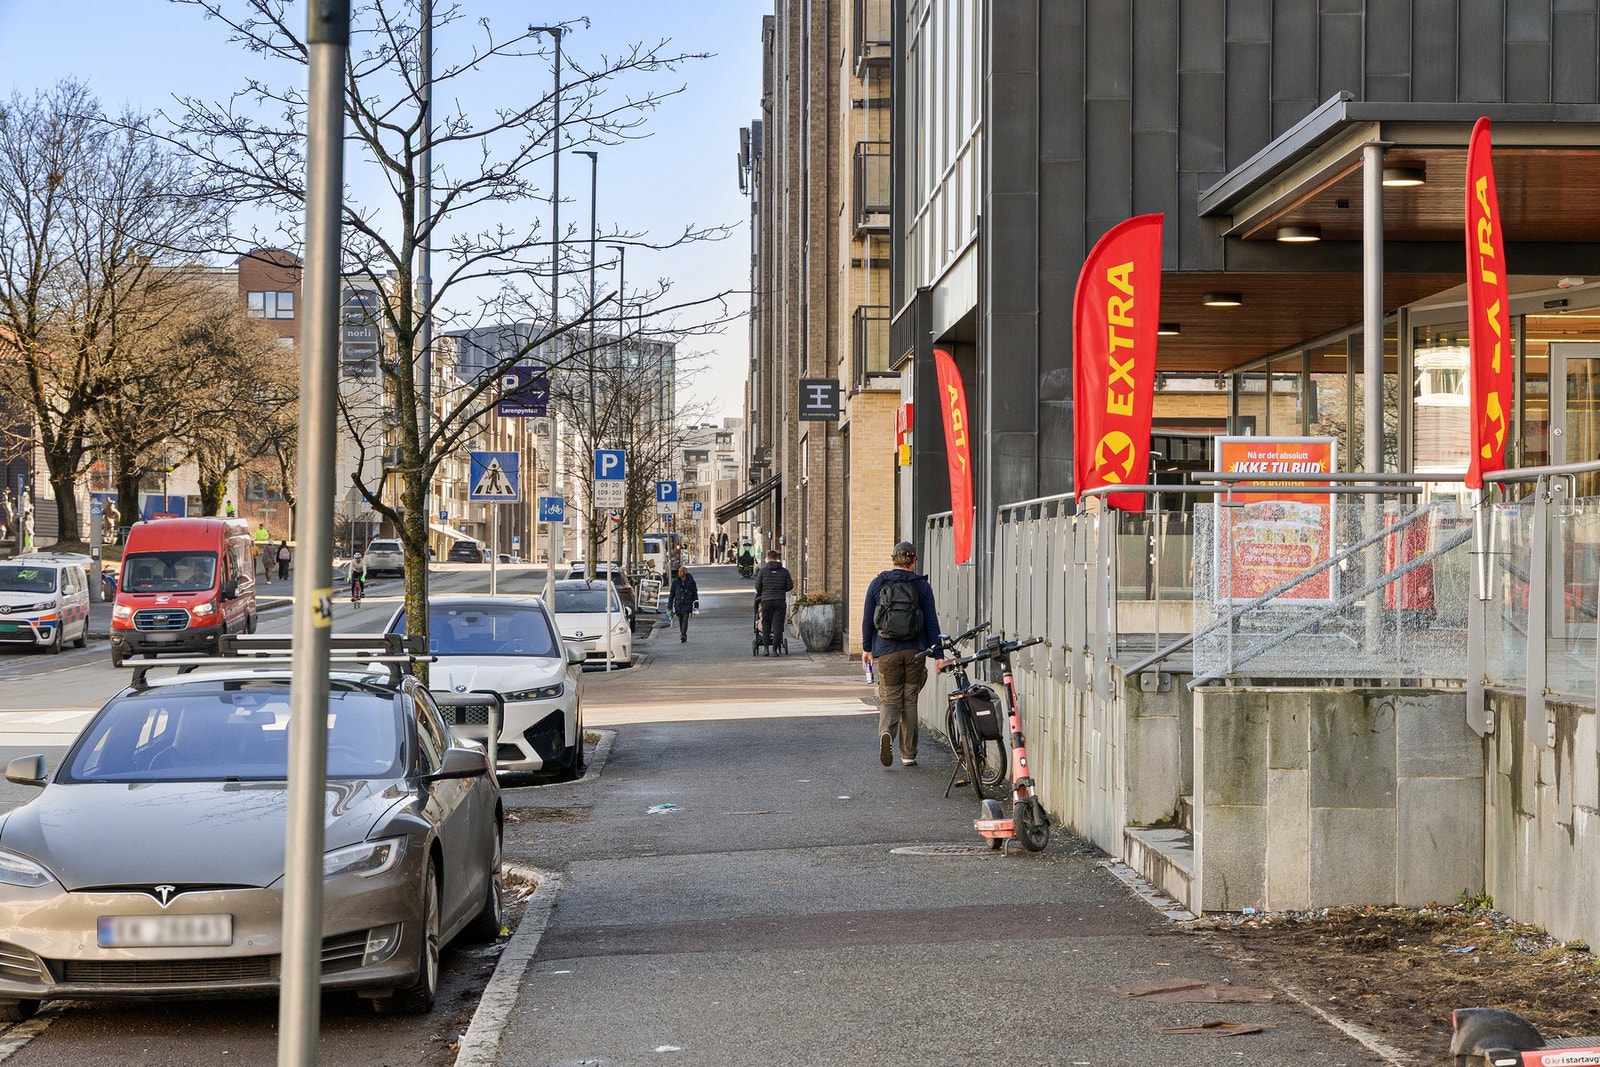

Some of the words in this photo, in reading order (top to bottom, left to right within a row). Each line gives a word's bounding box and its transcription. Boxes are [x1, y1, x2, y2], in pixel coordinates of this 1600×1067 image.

[347, 328, 372, 337] norli
[1107, 261, 1135, 417] EXTRA
[1247, 451, 1257, 459] Nå
[1279, 452, 1309, 460] absolutt
[602, 453, 618, 477] P
[1234, 462, 1269, 473] IKKE
[1271, 462, 1321, 473] TILBUD
[661, 484, 672, 500] P
